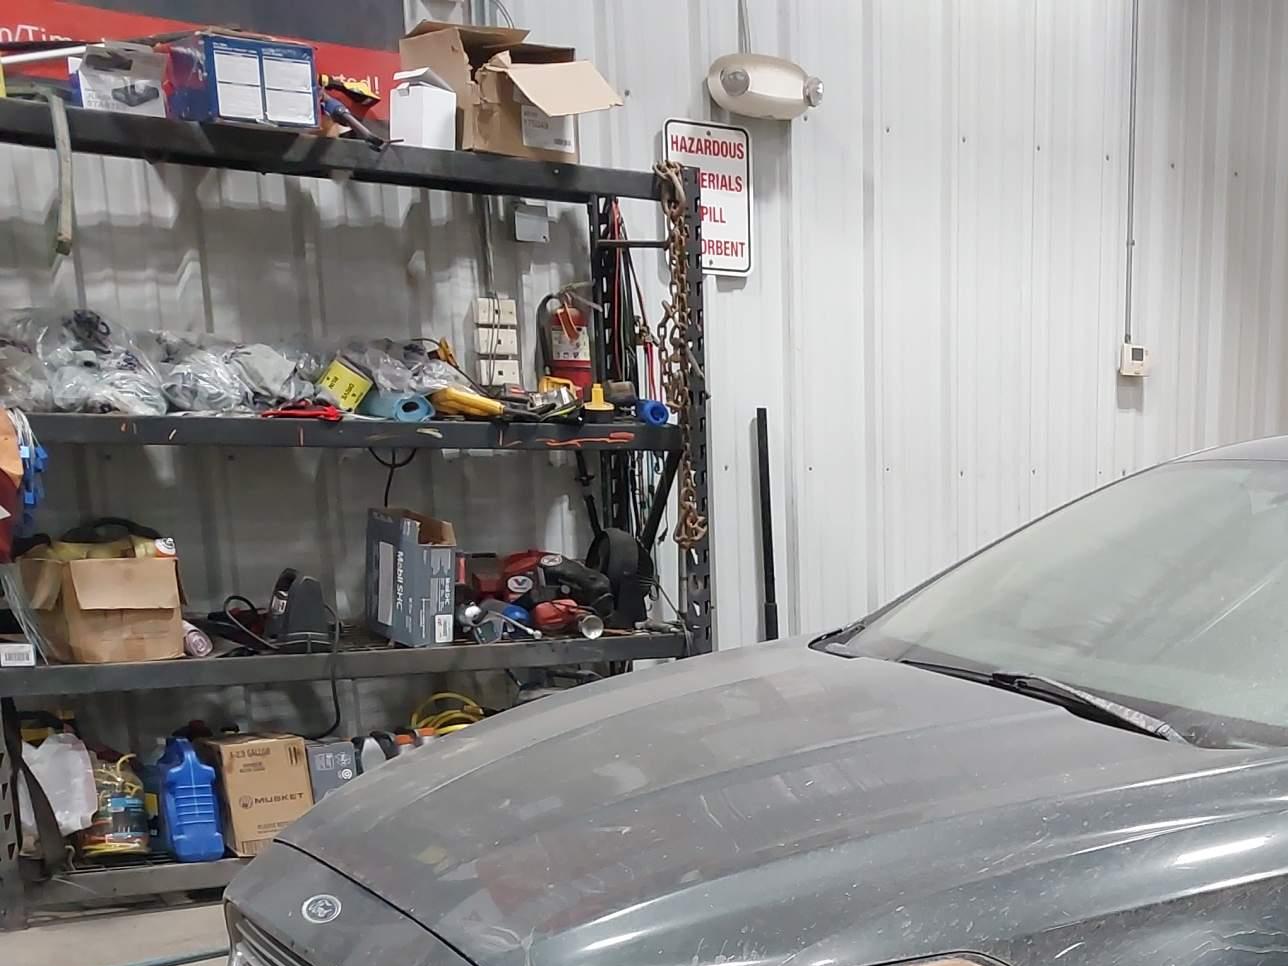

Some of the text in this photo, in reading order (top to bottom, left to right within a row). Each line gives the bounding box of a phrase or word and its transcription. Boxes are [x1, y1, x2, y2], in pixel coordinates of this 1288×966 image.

[670, 134, 745, 160] HAZARDOUS
[699, 172, 743, 193] ERIALS
[699, 205, 727, 224] PILL
[700, 238, 746, 258] ORBENT
[396, 550, 404, 613] Mobil SHC
[254, 792, 304, 805] MUSKET
